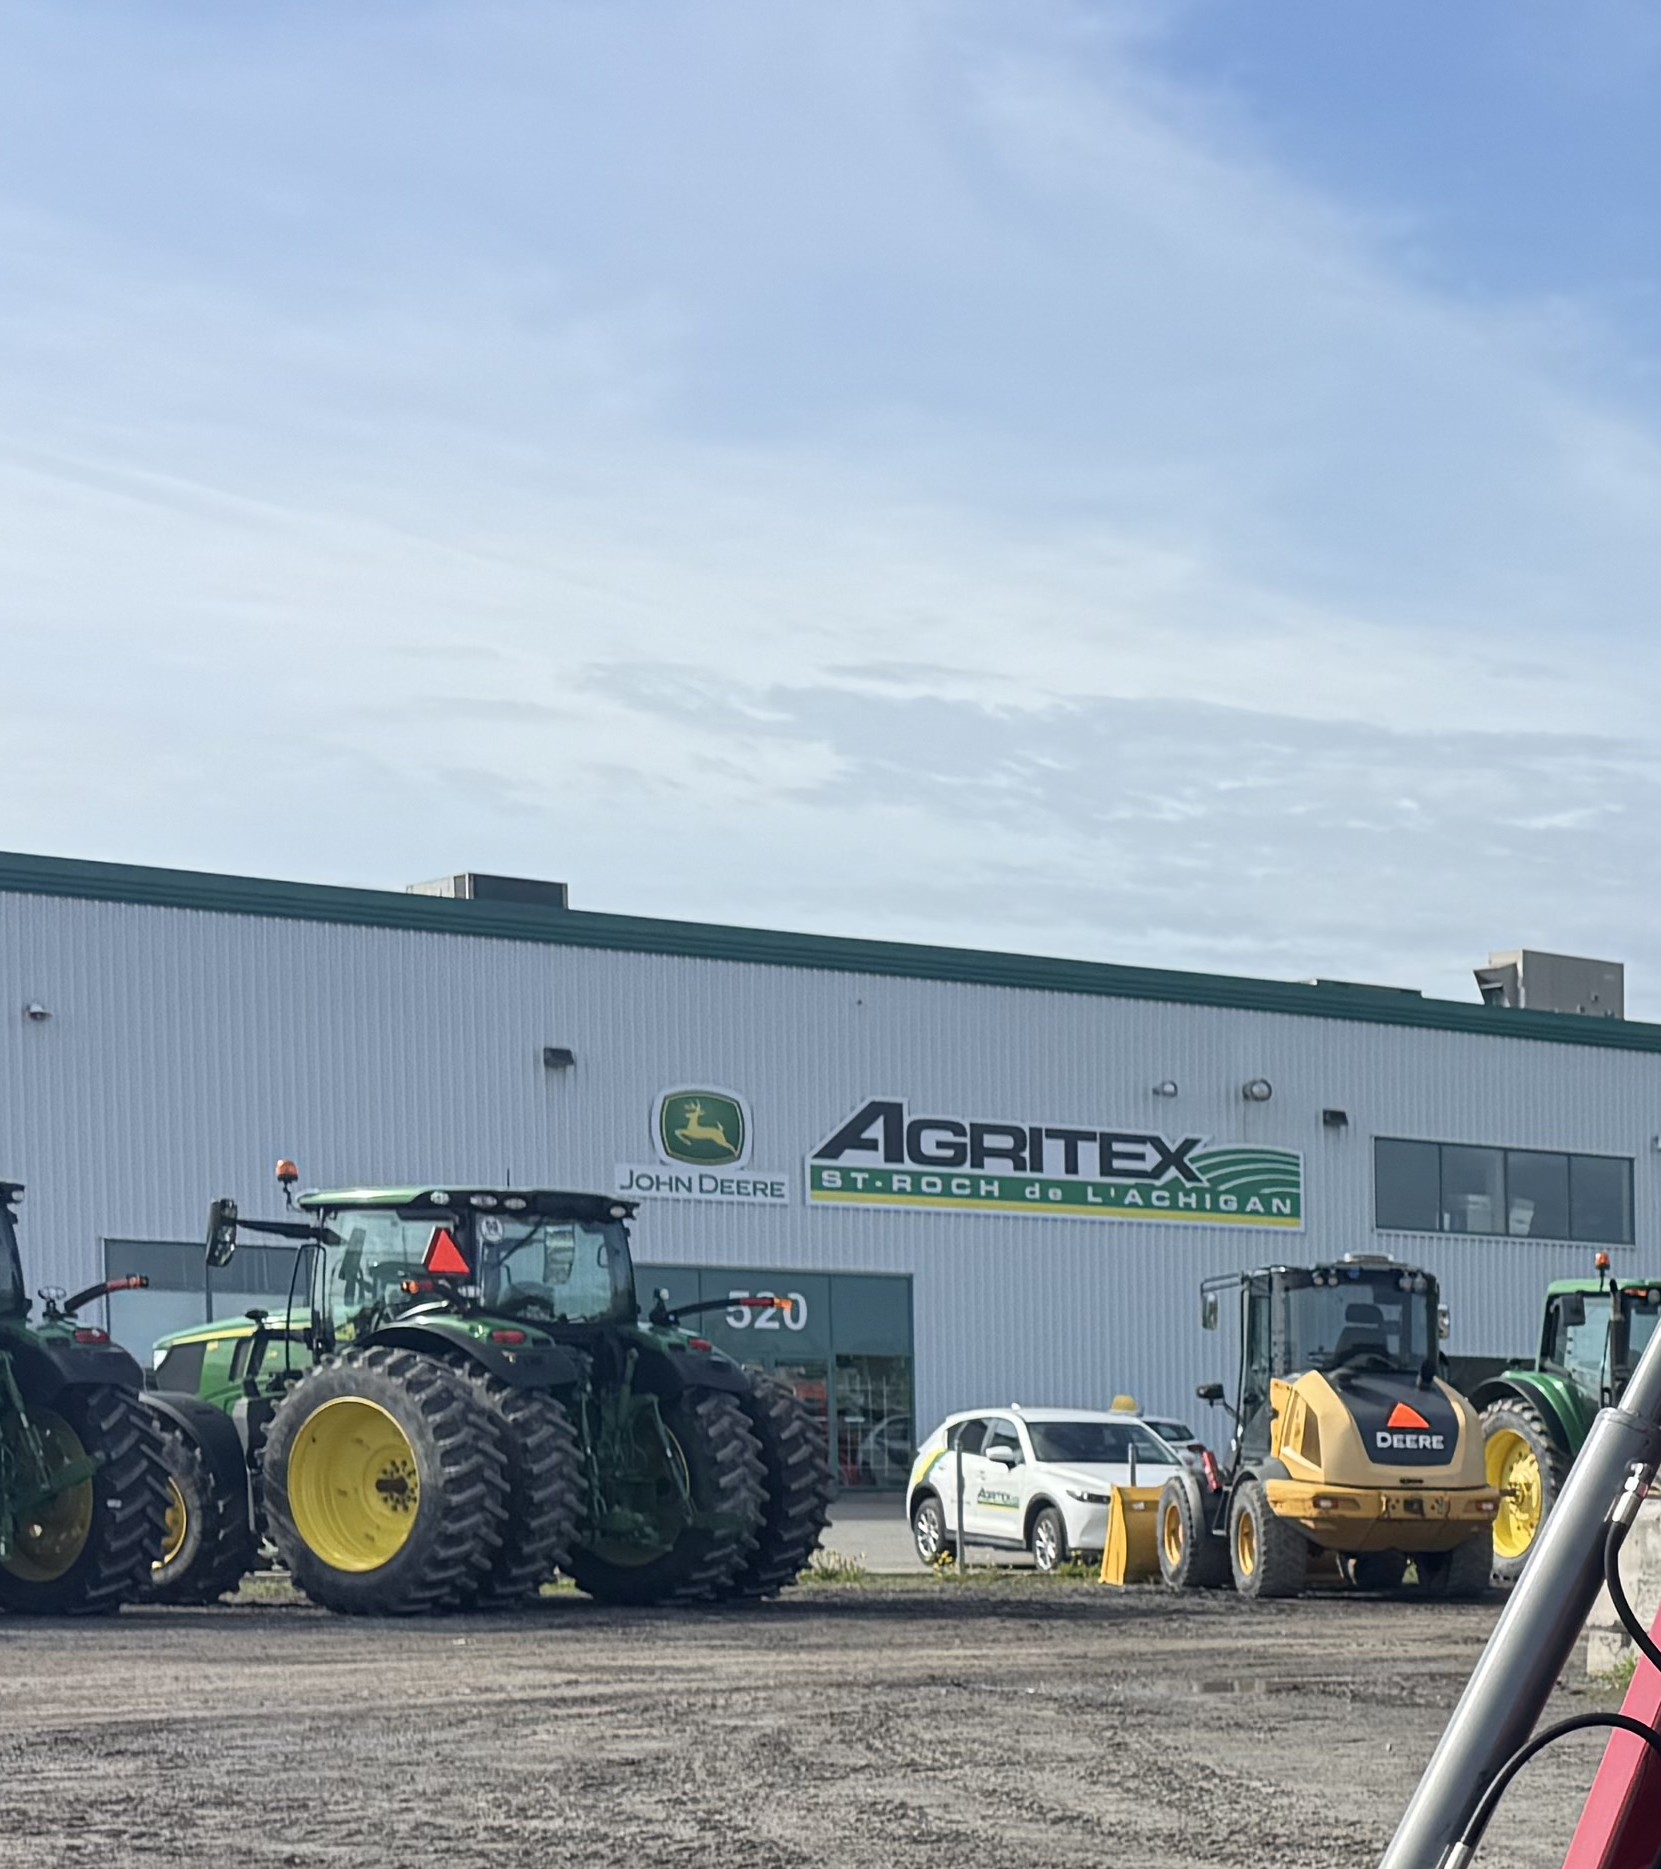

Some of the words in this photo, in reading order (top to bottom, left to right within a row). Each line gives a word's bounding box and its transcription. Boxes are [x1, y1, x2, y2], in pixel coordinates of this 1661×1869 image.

[811, 1101, 1204, 1184] AGRITEX
[619, 1169, 693, 1194] JOHN
[699, 1173, 786, 1198] DEERE
[1024, 1182, 1062, 1202] de
[1087, 1186, 1292, 1215] L'ACHIGAN
[725, 1290, 808, 1331] 520
[1375, 1431, 1445, 1450] DEERE
